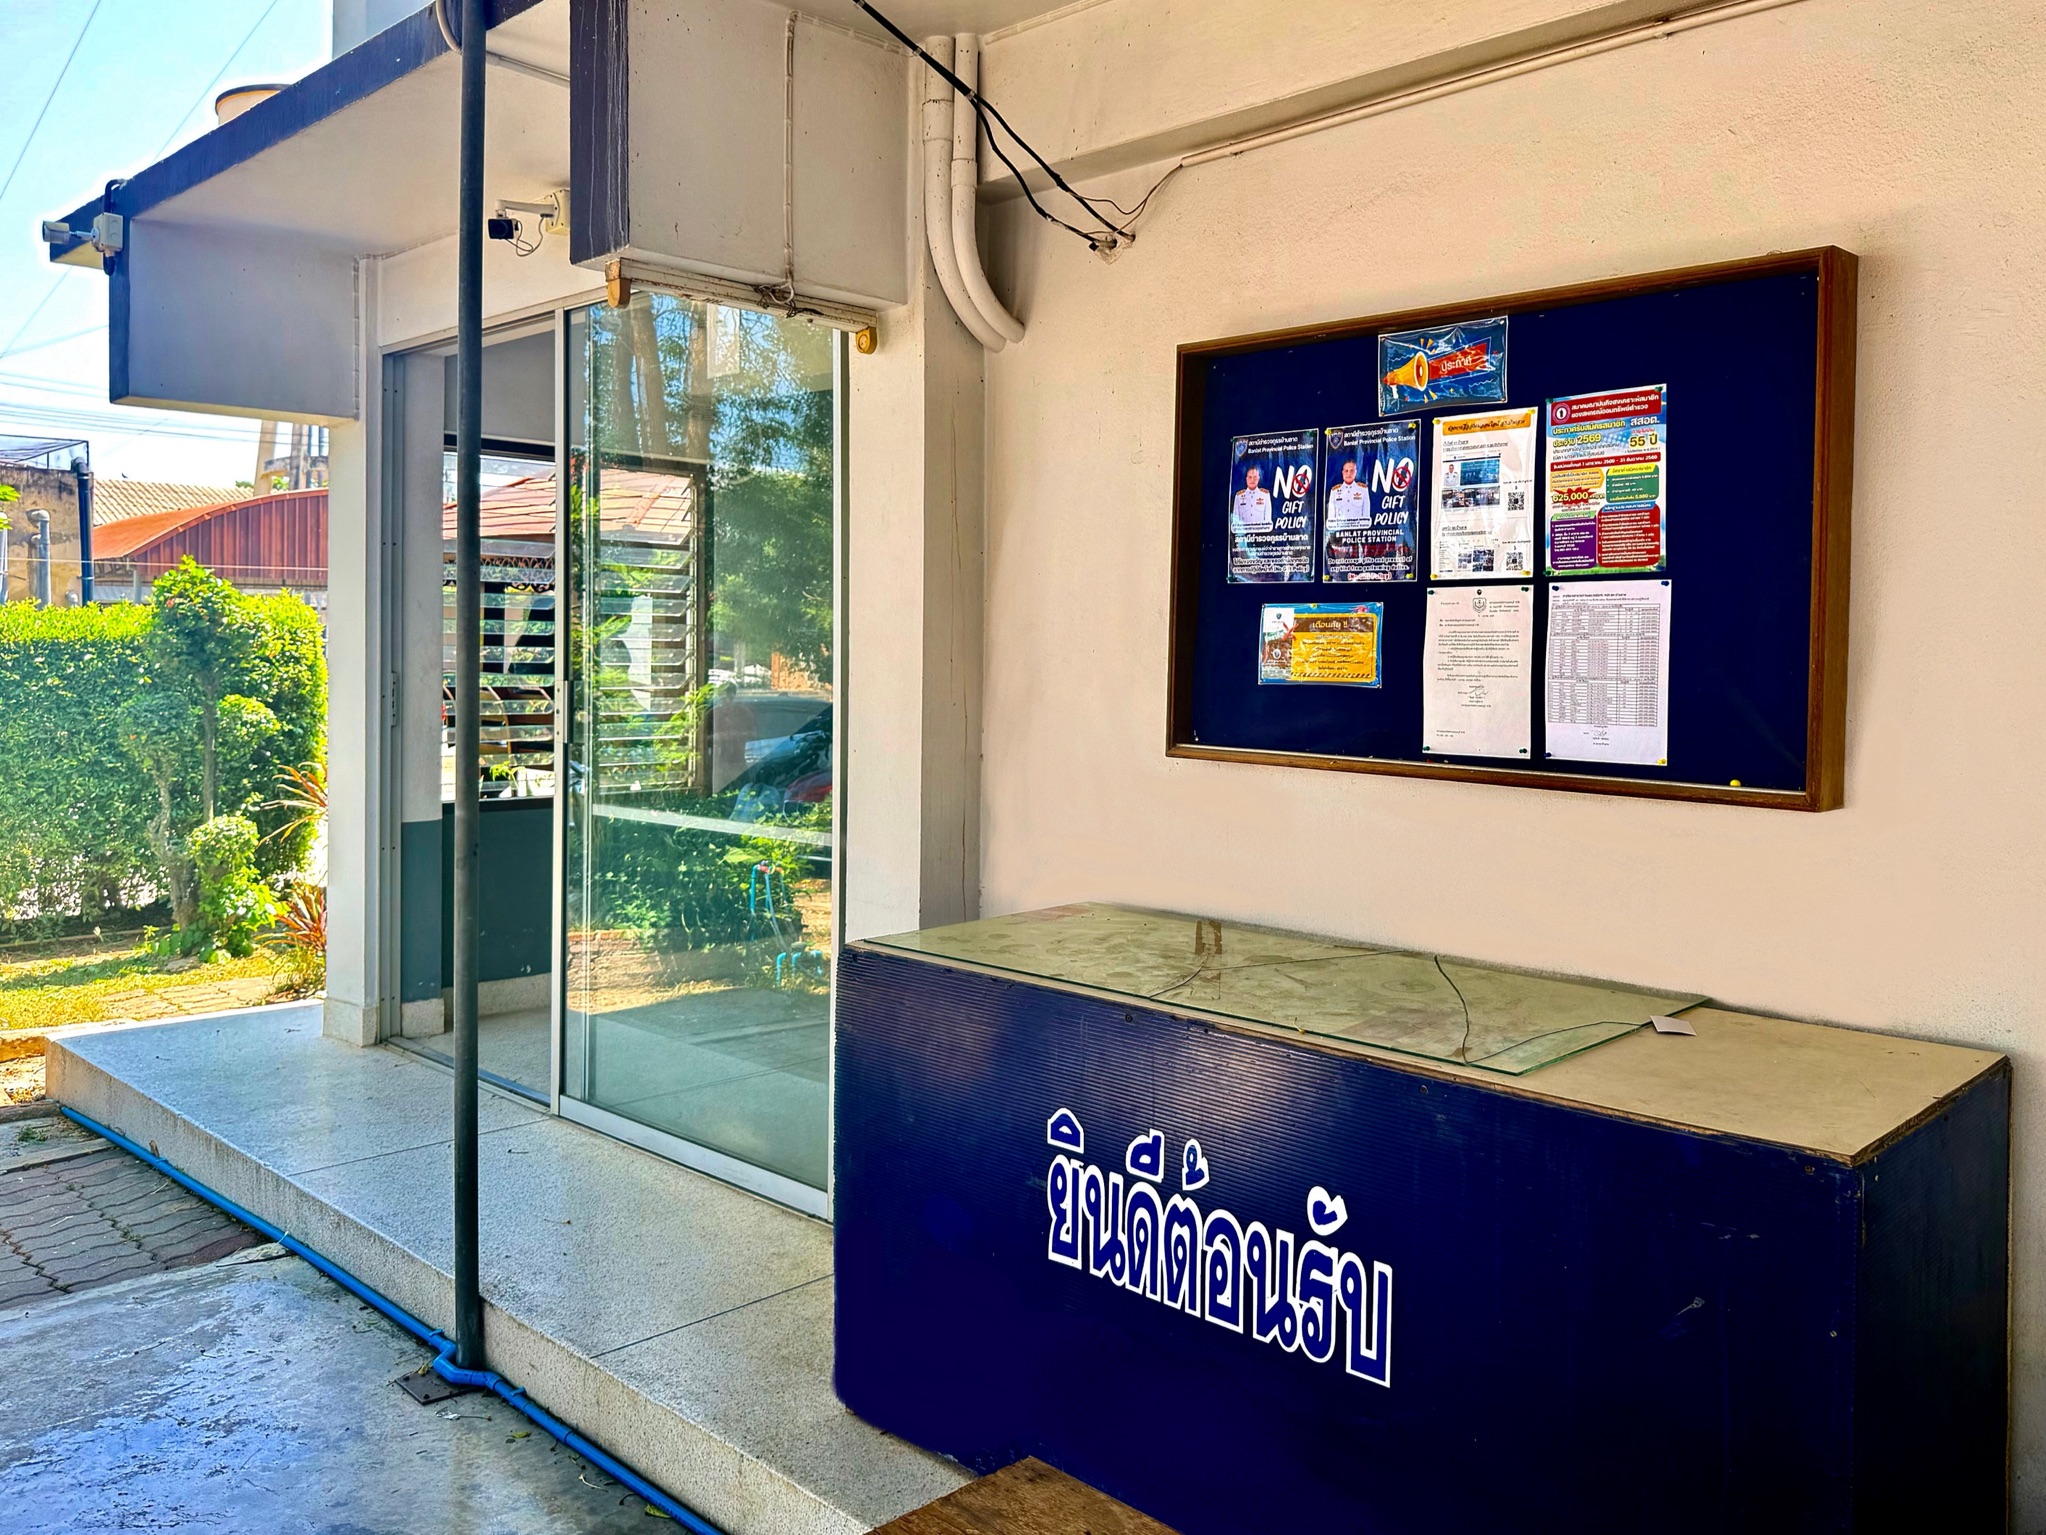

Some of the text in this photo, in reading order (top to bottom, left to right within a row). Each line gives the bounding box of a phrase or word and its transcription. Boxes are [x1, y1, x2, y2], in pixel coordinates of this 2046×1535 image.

[1441, 354, 1473, 373] ประกาศ
[1577, 433, 1602, 445] 2569
[1629, 432, 1658, 448] 55 ปี
[1272, 464, 1313, 500] NO
[1371, 457, 1415, 494] NO
[1381, 495, 1406, 510] GIFT
[1551, 492, 1589, 502] 625,000
[1281, 500, 1305, 515] GIFT
[1274, 515, 1308, 530] POLICY
[1373, 511, 1409, 526] POLICY
[1234, 532, 1309, 544] สถานีตำรวจภูธรบ้านลาด
[1335, 529, 1404, 538] BANLAT PROVINCIAL
[1311, 619, 1342, 629] เตือนภัย
[1047, 1107, 1392, 1388] ยินดีต้อนรับ
